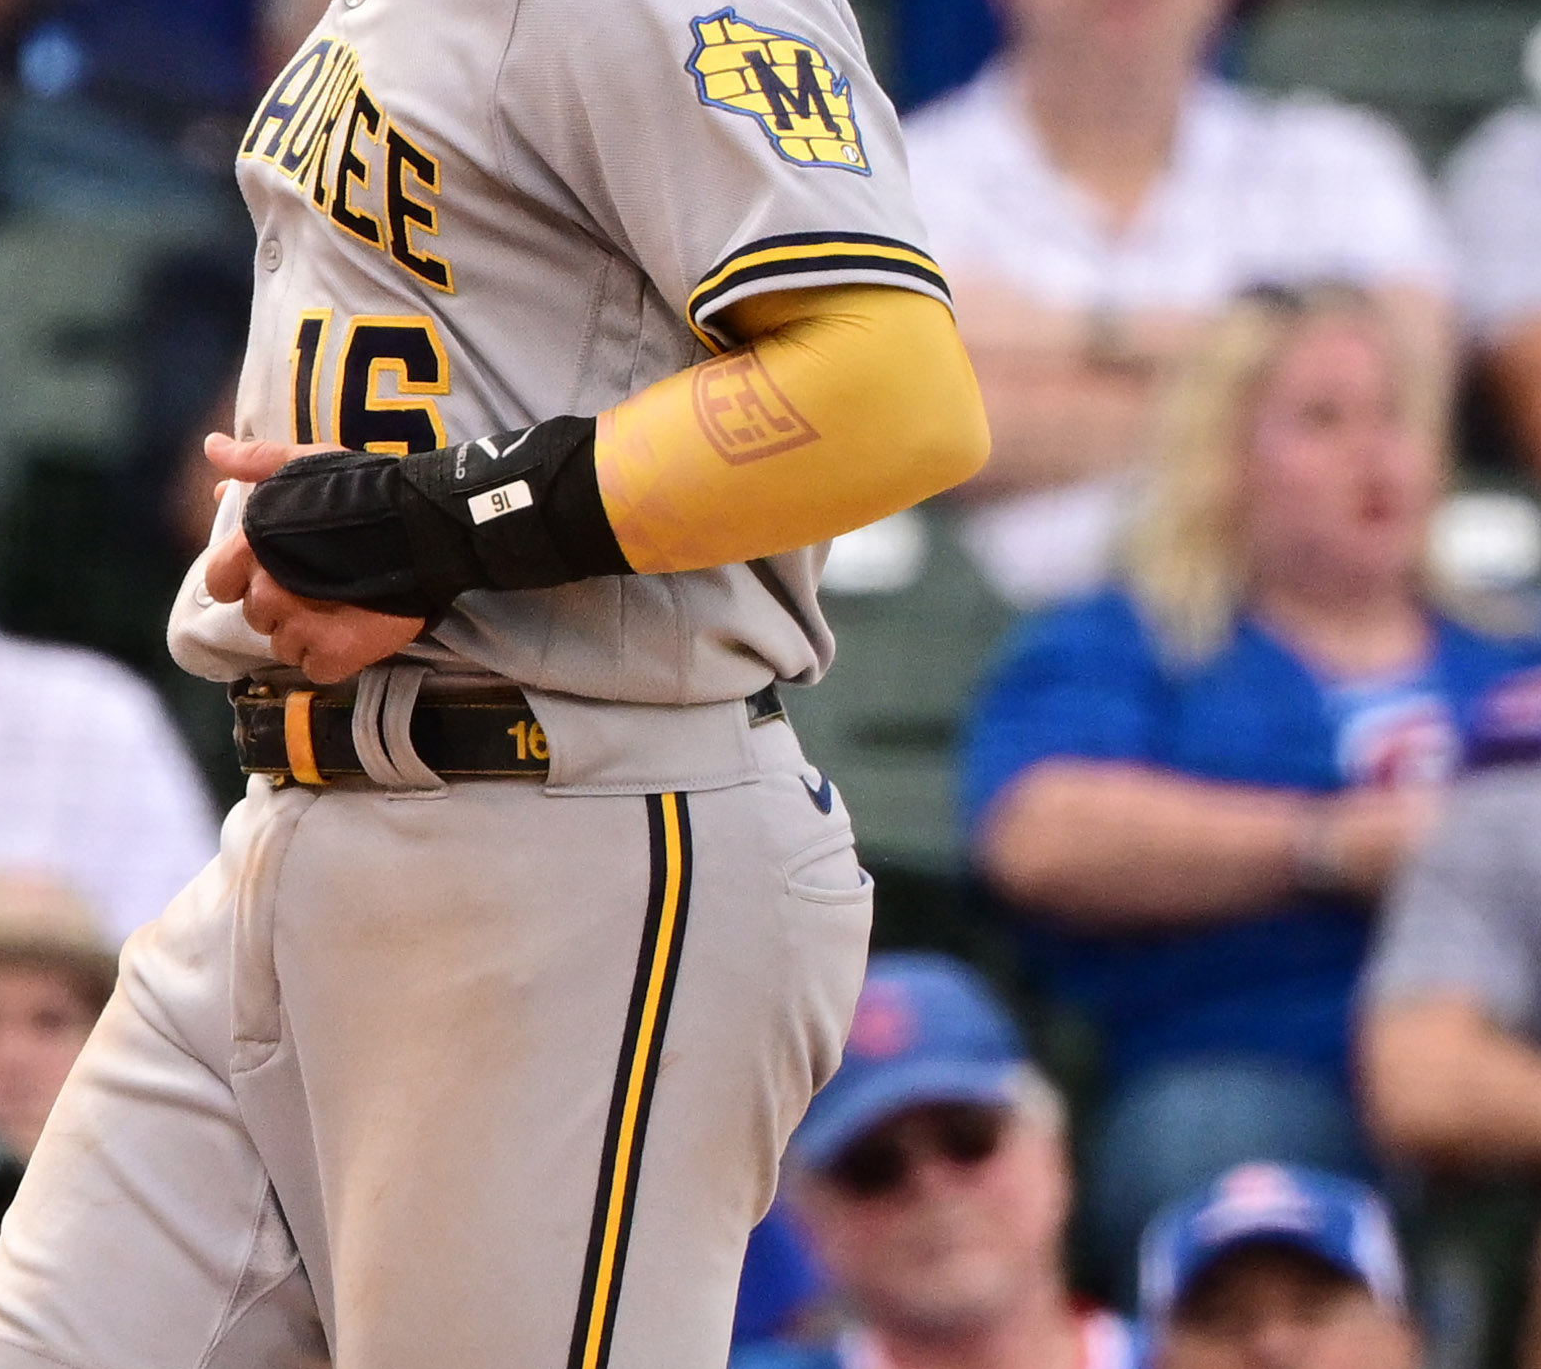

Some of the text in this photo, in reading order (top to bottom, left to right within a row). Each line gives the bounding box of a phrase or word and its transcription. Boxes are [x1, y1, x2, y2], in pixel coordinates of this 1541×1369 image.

[741, 50, 841, 134] M
[289, 308, 450, 458] 16
[506, 720, 550, 760] 16
